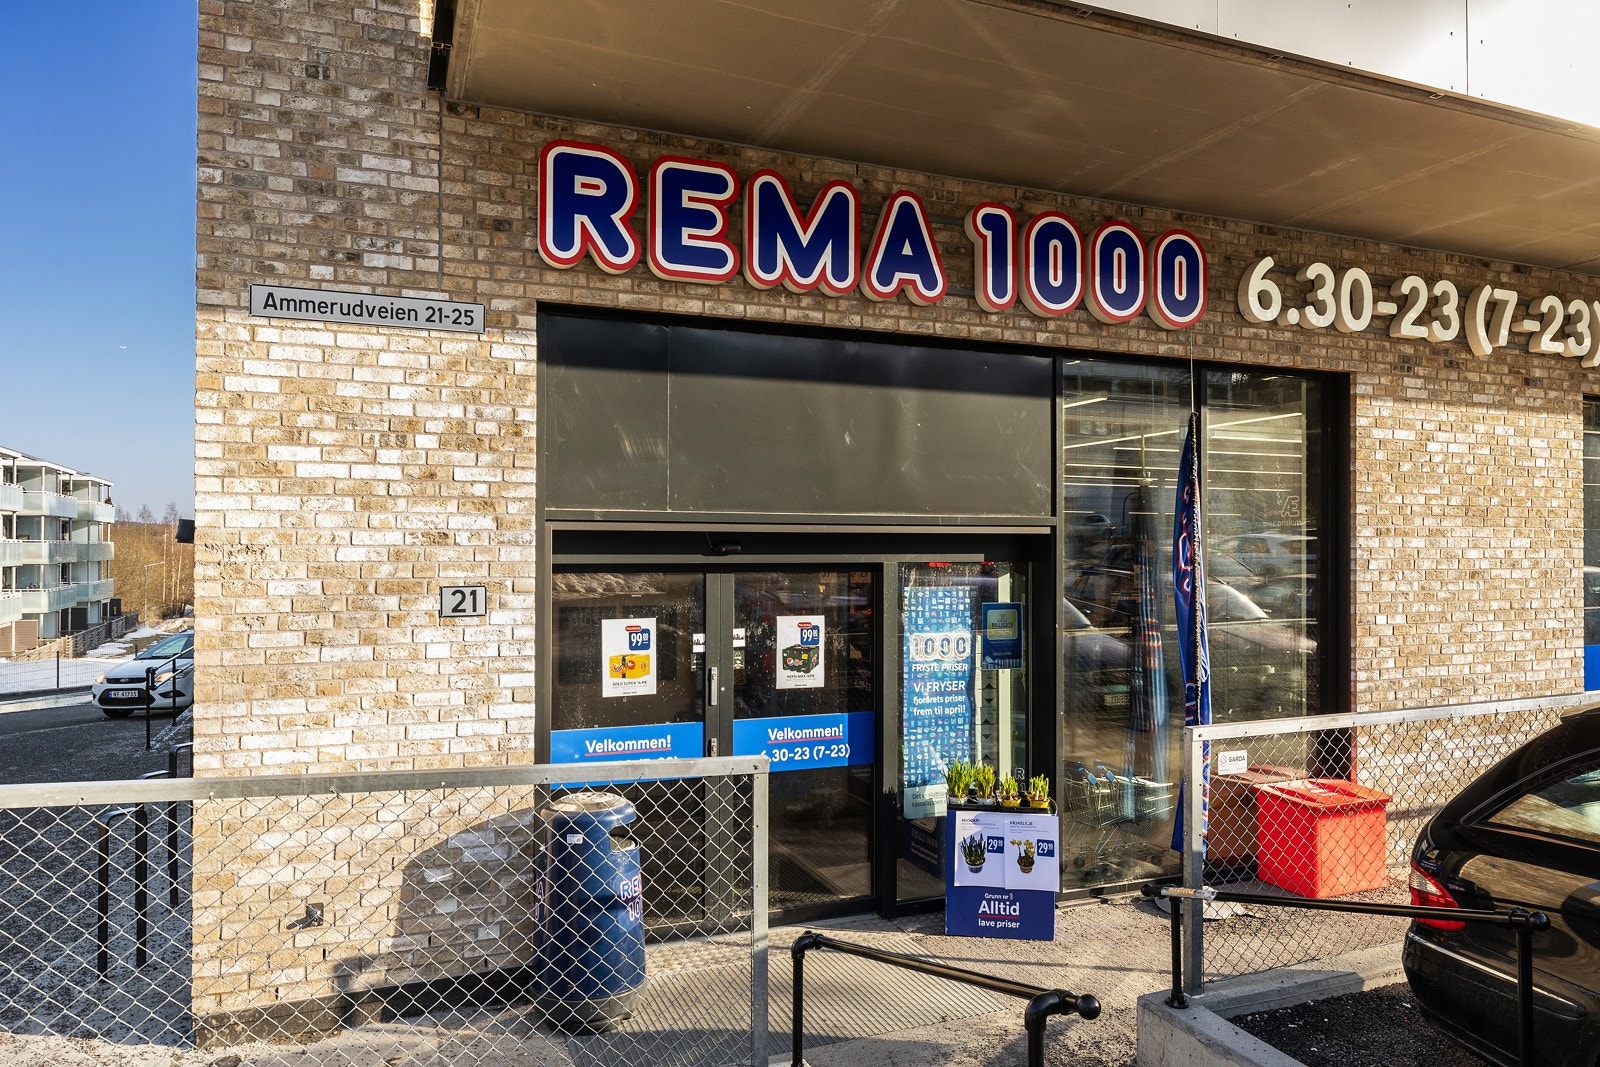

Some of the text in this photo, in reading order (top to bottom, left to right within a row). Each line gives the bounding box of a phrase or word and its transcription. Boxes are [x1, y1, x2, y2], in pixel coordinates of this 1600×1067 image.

[538, 139, 1208, 330] REMA 1000
[262, 291, 475, 326] Ammerudveien 21-25
[1238, 256, 1460, 343] 6.30-23
[450, 589, 478, 613] 21
[910, 634, 969, 659] 1000
[911, 662, 968, 672] FRYSTE PRISER
[913, 680, 966, 692] Vi FRYSER
[944, 693, 966, 704] priser
[913, 704, 966, 716] frem til april!
[767, 723, 843, 741] Velkommen!
[585, 734, 671, 753] Velkommen!
[813, 743, 851, 761] (7-23)
[1228, 755, 1246, 763] GARDA
[978, 900, 1020, 916] Alltid
[978, 918, 1021, 929] lave priser
